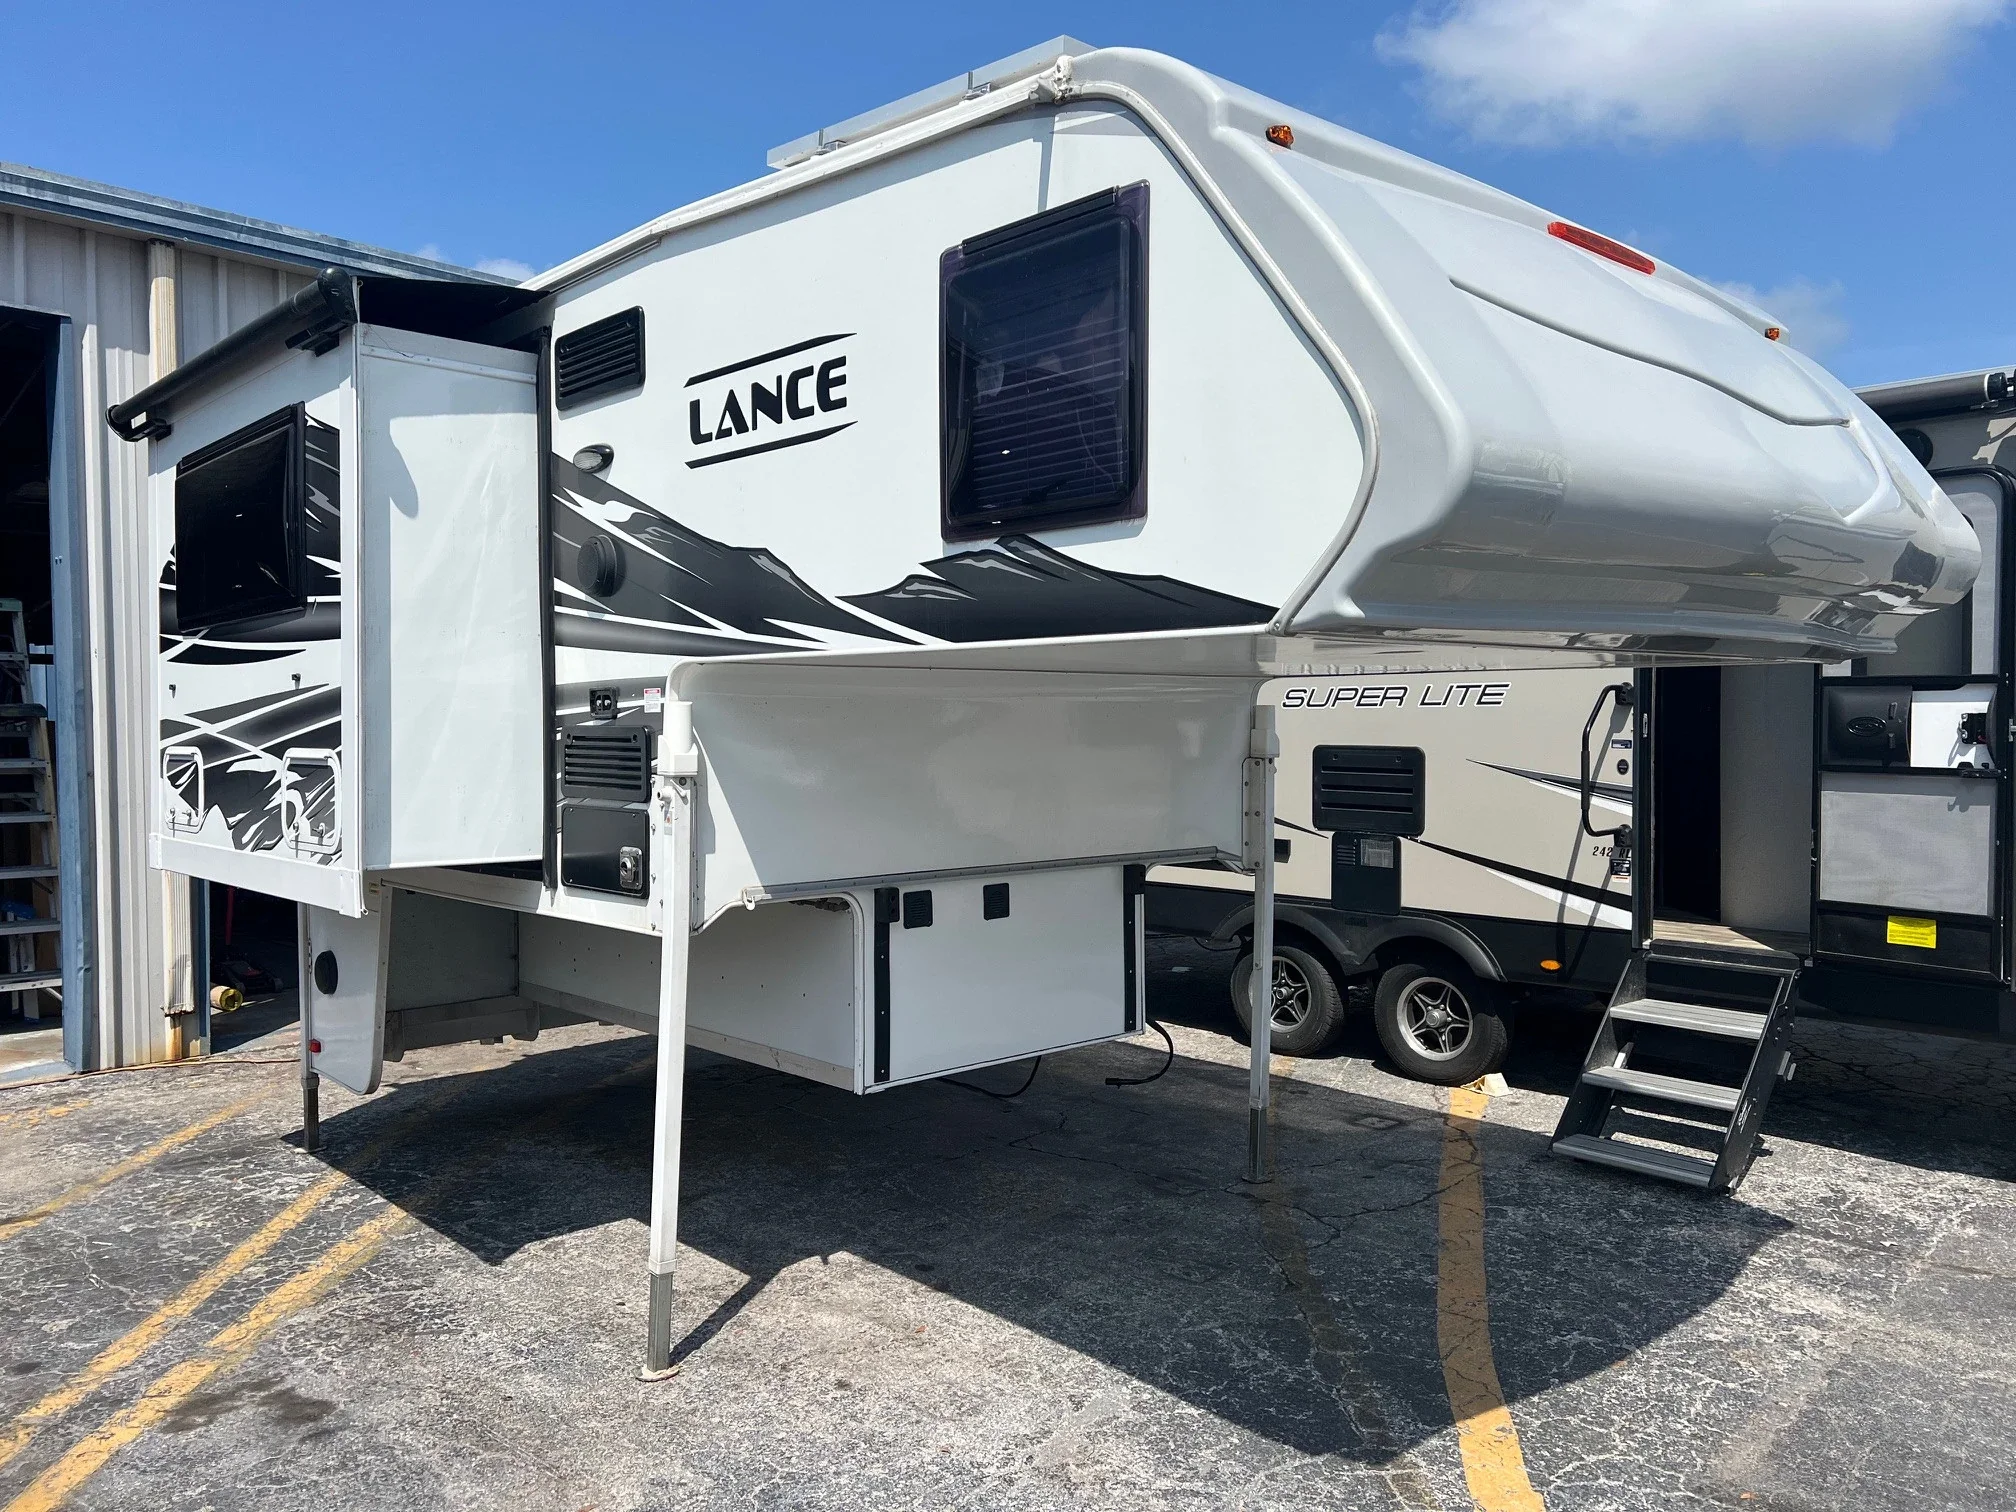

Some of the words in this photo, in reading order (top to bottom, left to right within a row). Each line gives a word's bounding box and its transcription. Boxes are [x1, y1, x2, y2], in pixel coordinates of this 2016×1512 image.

[689, 355, 847, 446] LANCE
[1282, 684, 1409, 709] SUPER
[1418, 682, 1511, 708] LITE
[1592, 845, 1613, 857] 242
